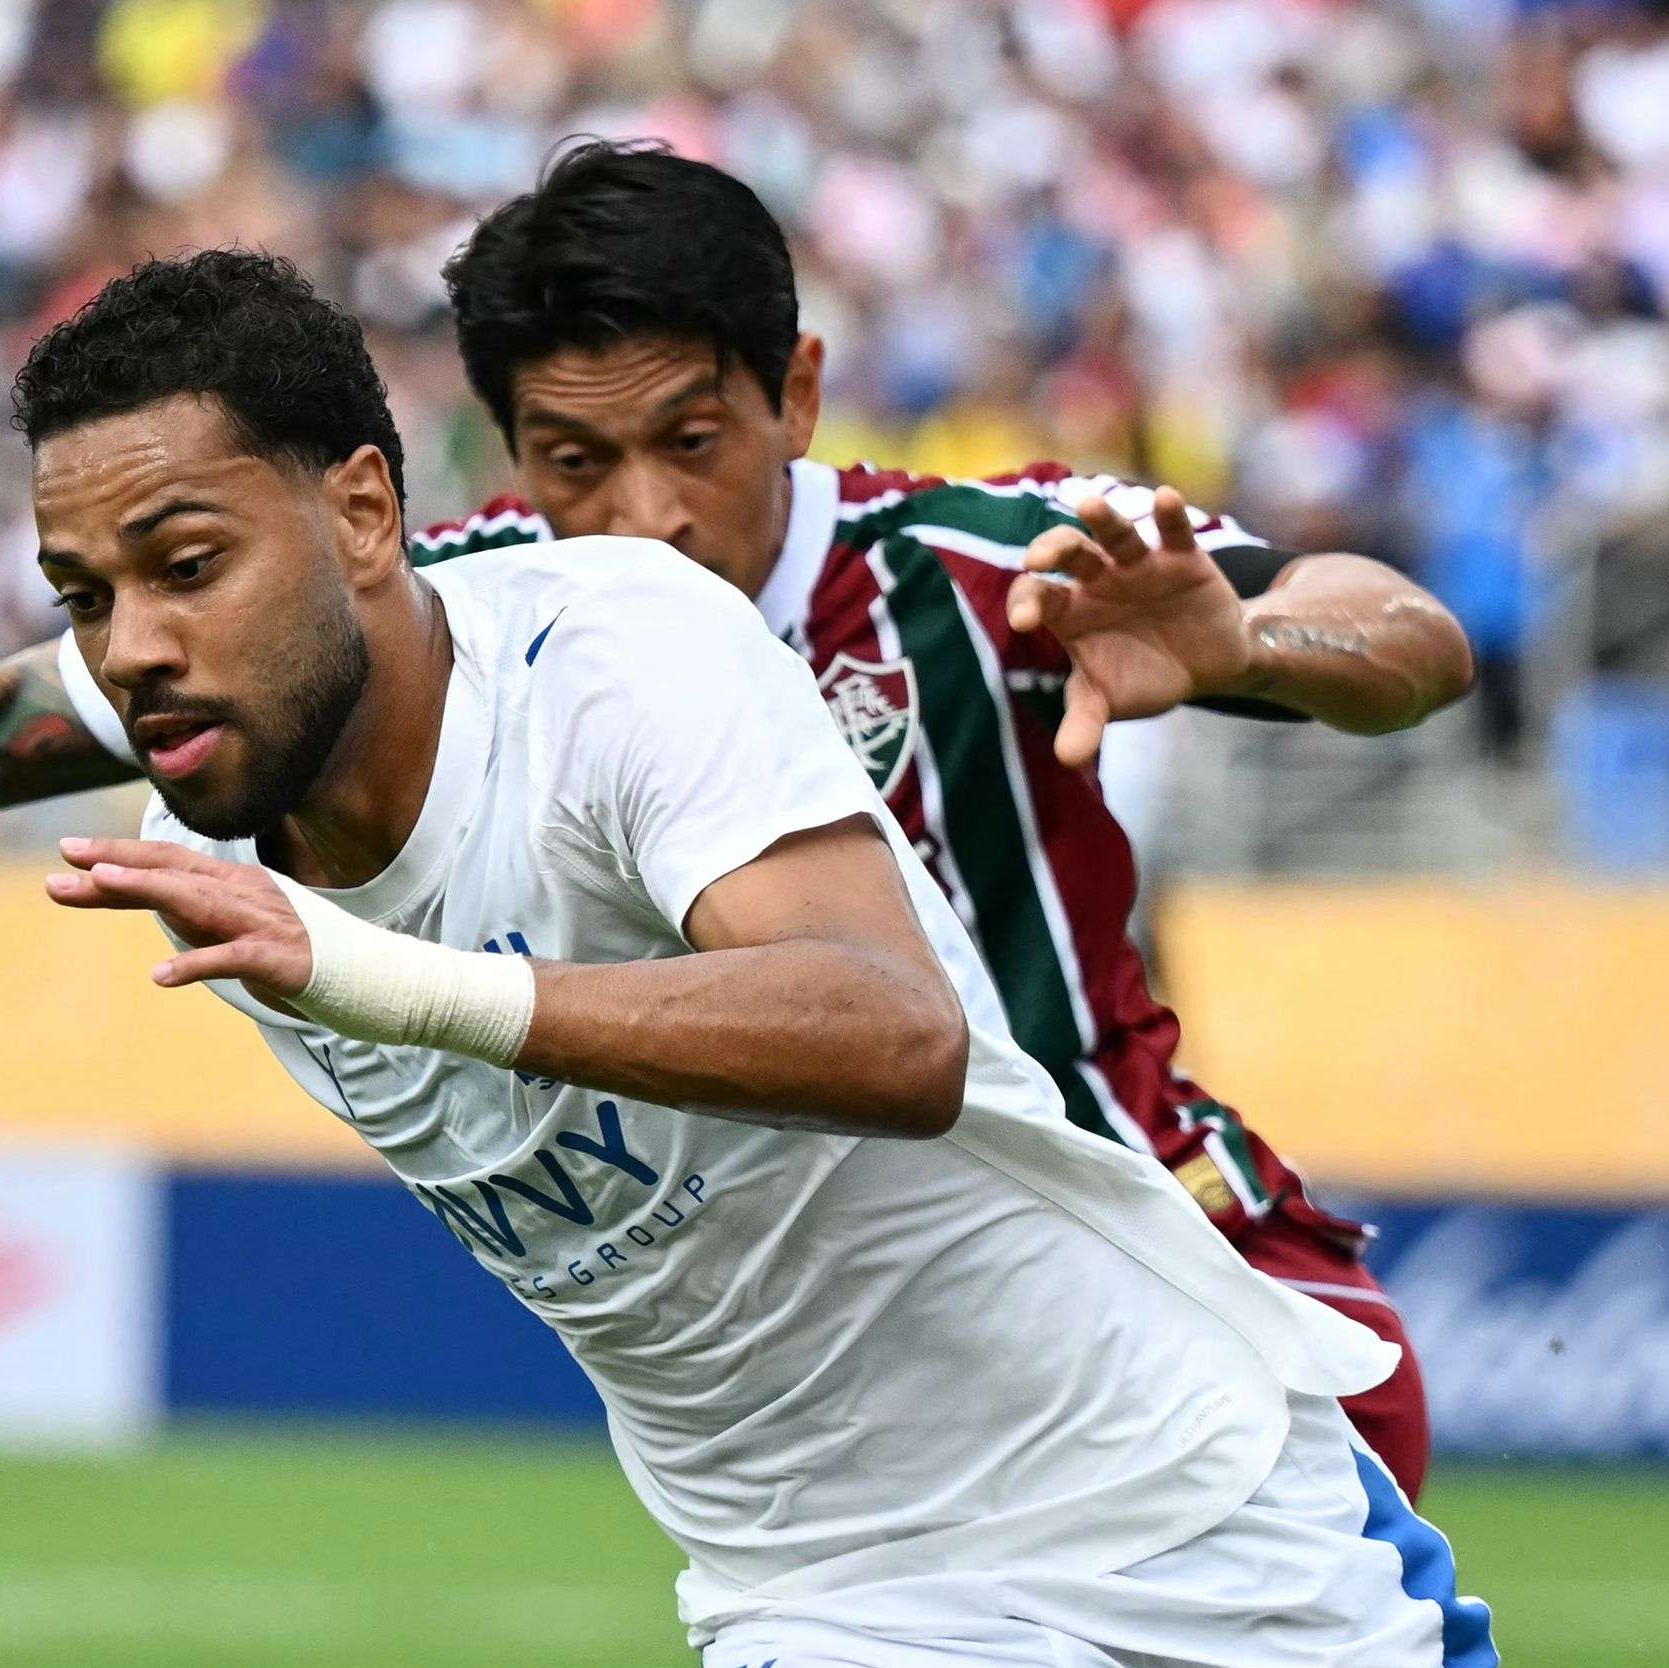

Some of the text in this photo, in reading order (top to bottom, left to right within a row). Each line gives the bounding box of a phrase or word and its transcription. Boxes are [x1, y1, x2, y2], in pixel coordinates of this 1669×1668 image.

[416, 1101, 659, 1257] AVVY
[510, 1173, 708, 1299] ES GROUP
